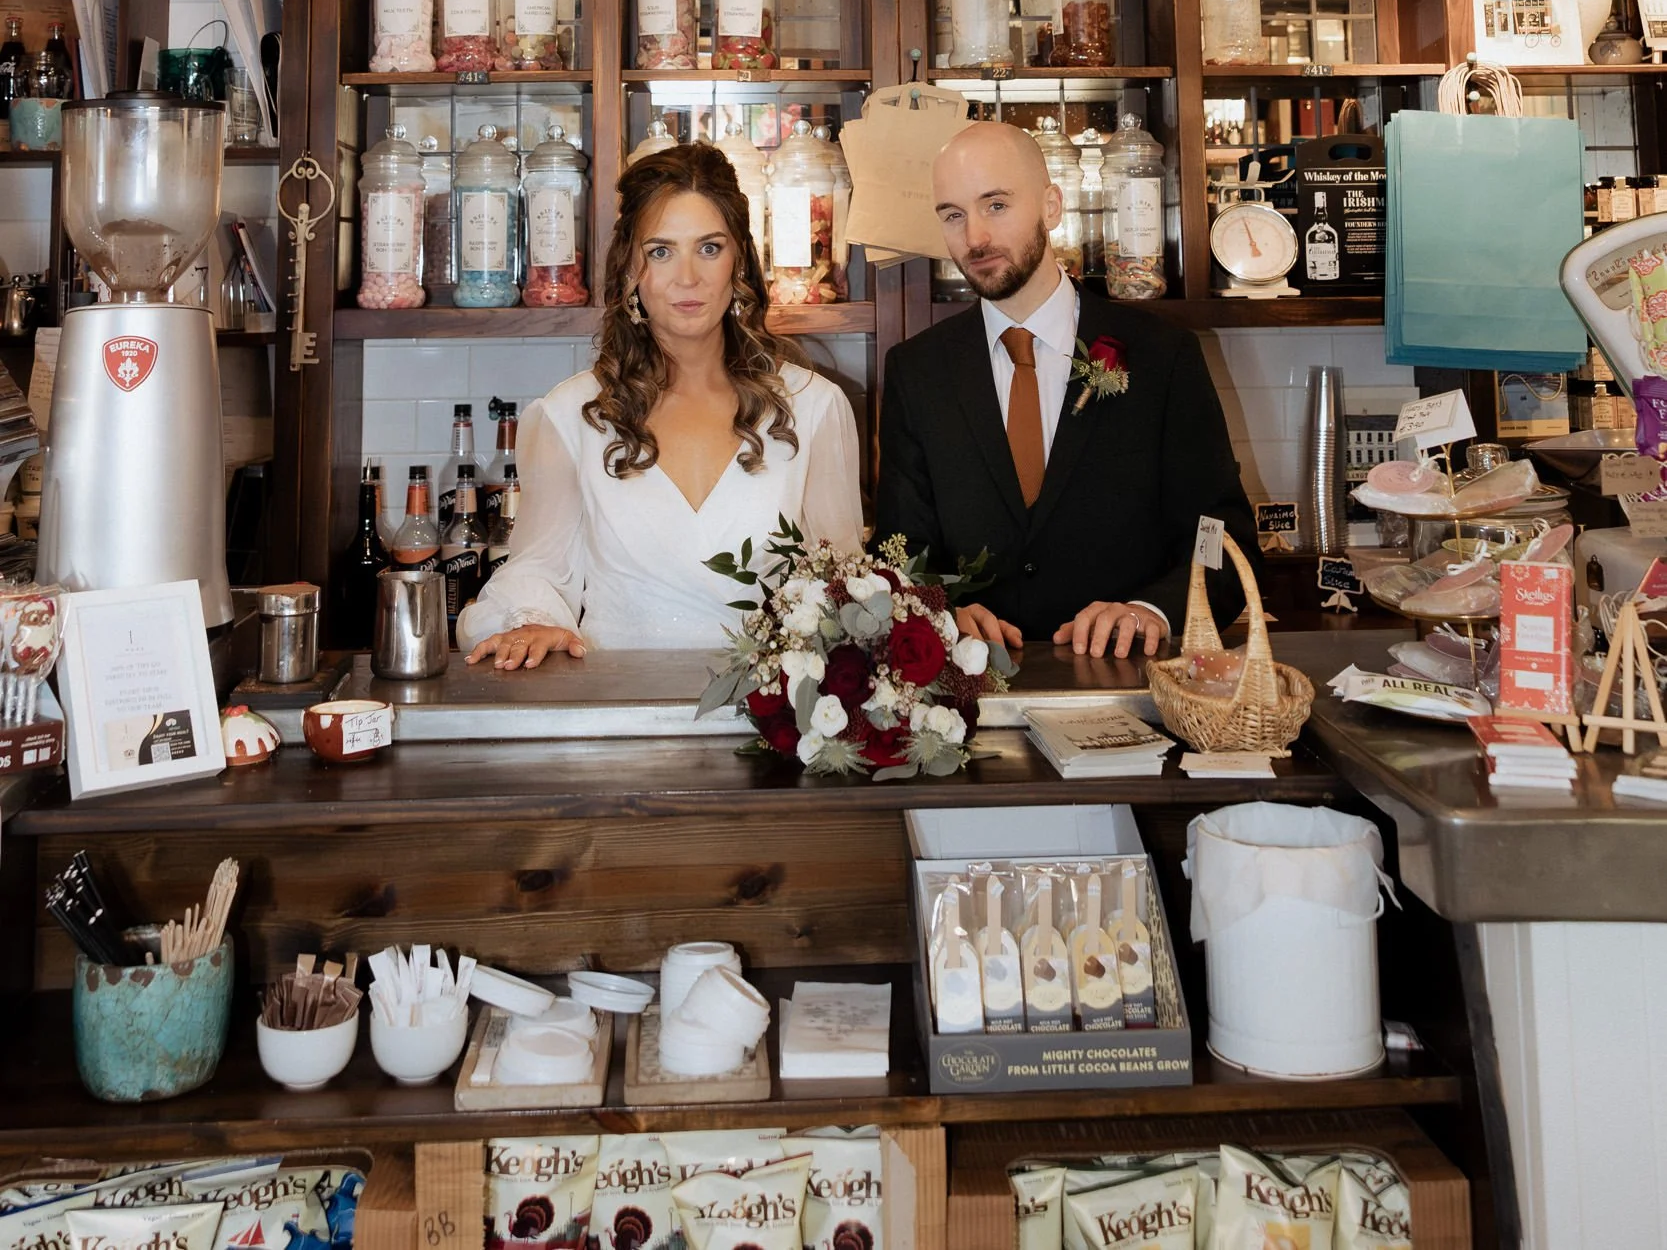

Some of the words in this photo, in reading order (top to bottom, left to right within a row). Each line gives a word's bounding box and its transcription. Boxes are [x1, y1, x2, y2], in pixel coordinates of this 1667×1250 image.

[1304, 171, 1341, 183] Whiskey
[1343, 171, 1354, 181] of
[1354, 171, 1369, 181] the
[1346, 190, 1364, 198] THE
[109, 341, 149, 354] EUREKA
[446, 554, 477, 574] DaVinci
[448, 578, 457, 615] HAZELNUT
[1382, 679, 1409, 689] ALL
[1413, 682, 1452, 696] REAL
[1043, 1051, 1084, 1061] MIGHTY
[1087, 1047, 1157, 1059] CHOCOLATES
[1008, 1065, 1039, 1076] FROM
[1042, 1064, 1074, 1075] LITTLE
[1078, 1063, 1116, 1073] COCOA
[1120, 1061, 1153, 1071] BEANS
[1157, 1060, 1189, 1070] GROW
